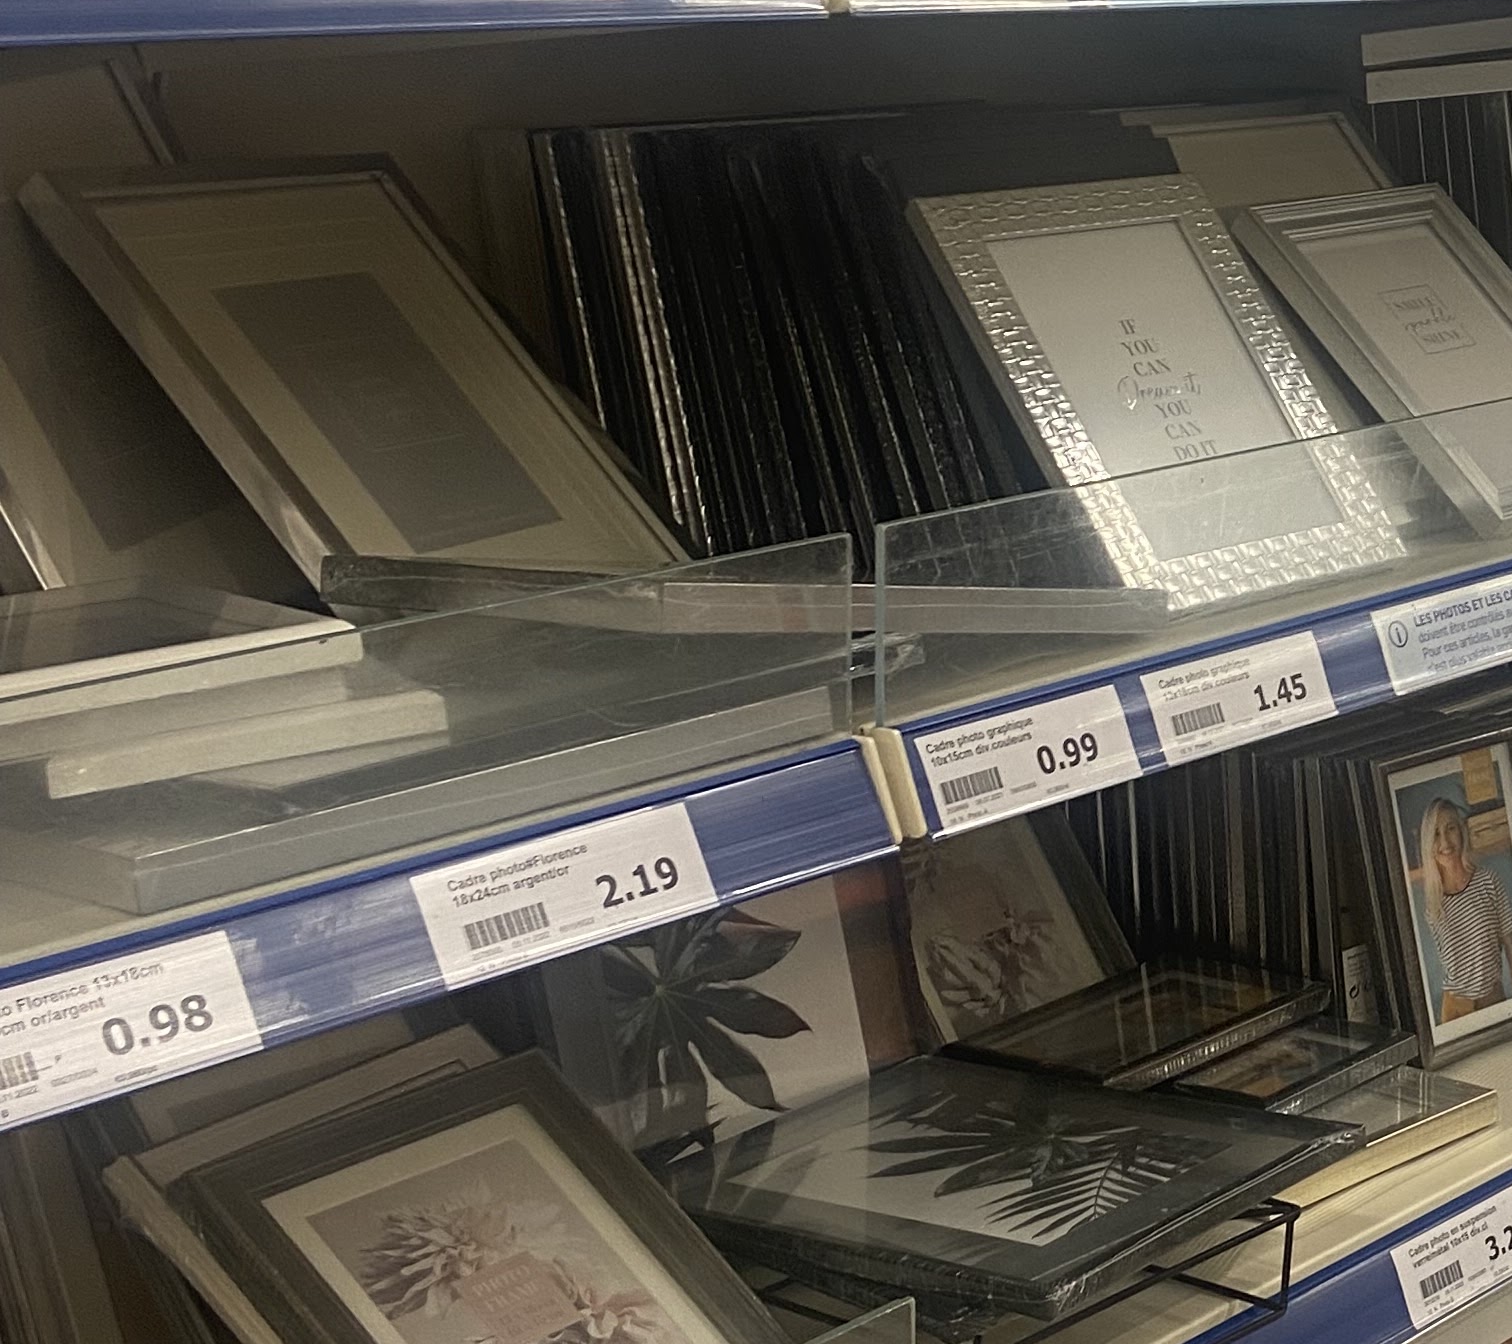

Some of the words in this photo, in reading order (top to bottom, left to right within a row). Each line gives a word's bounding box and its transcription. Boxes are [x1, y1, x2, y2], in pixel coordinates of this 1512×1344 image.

[1119, 319, 1136, 335] IF
[1120, 338, 1160, 357] YOU
[1133, 358, 1172, 376] CAN
[1155, 399, 1192, 419] YOU
[1165, 421, 1202, 440] CAN
[1173, 443, 1199, 461] DO
[1201, 440, 1218, 455] IT
[1413, 611, 1433, 627] LES
[1434, 601, 1471, 623] PHOTOS
[1471, 598, 1484, 612] ET
[1484, 591, 1503, 608] LES
[1419, 627, 1449, 644] doivent
[1422, 643, 1443, 659] Pour
[1158, 675, 1184, 690] Cadre
[1185, 667, 1209, 684] photo
[1210, 658, 1250, 676] graphique
[1253, 672, 1307, 712] 1.45
[925, 739, 955, 754] Cadre
[957, 731, 985, 748] photo
[987, 716, 1033, 740] graphique
[931, 749, 973, 767] 10x15cm
[1037, 732, 1098, 775] 0.99
[447, 869, 487, 894] Cadre
[594, 857, 679, 910] 2.19
[452, 882, 511, 909] 18x24cm
[16, 981, 89, 1012] Florence
[92, 961, 164, 990] 13x18cm
[30, 996, 106, 1028] or/argent
[102, 994, 214, 1056] 0.98
[1408, 1244, 1429, 1258] Cadre
[1430, 1232, 1450, 1248] photo
[1450, 1226, 1459, 1235] en
[1460, 1205, 1497, 1231] suspension
